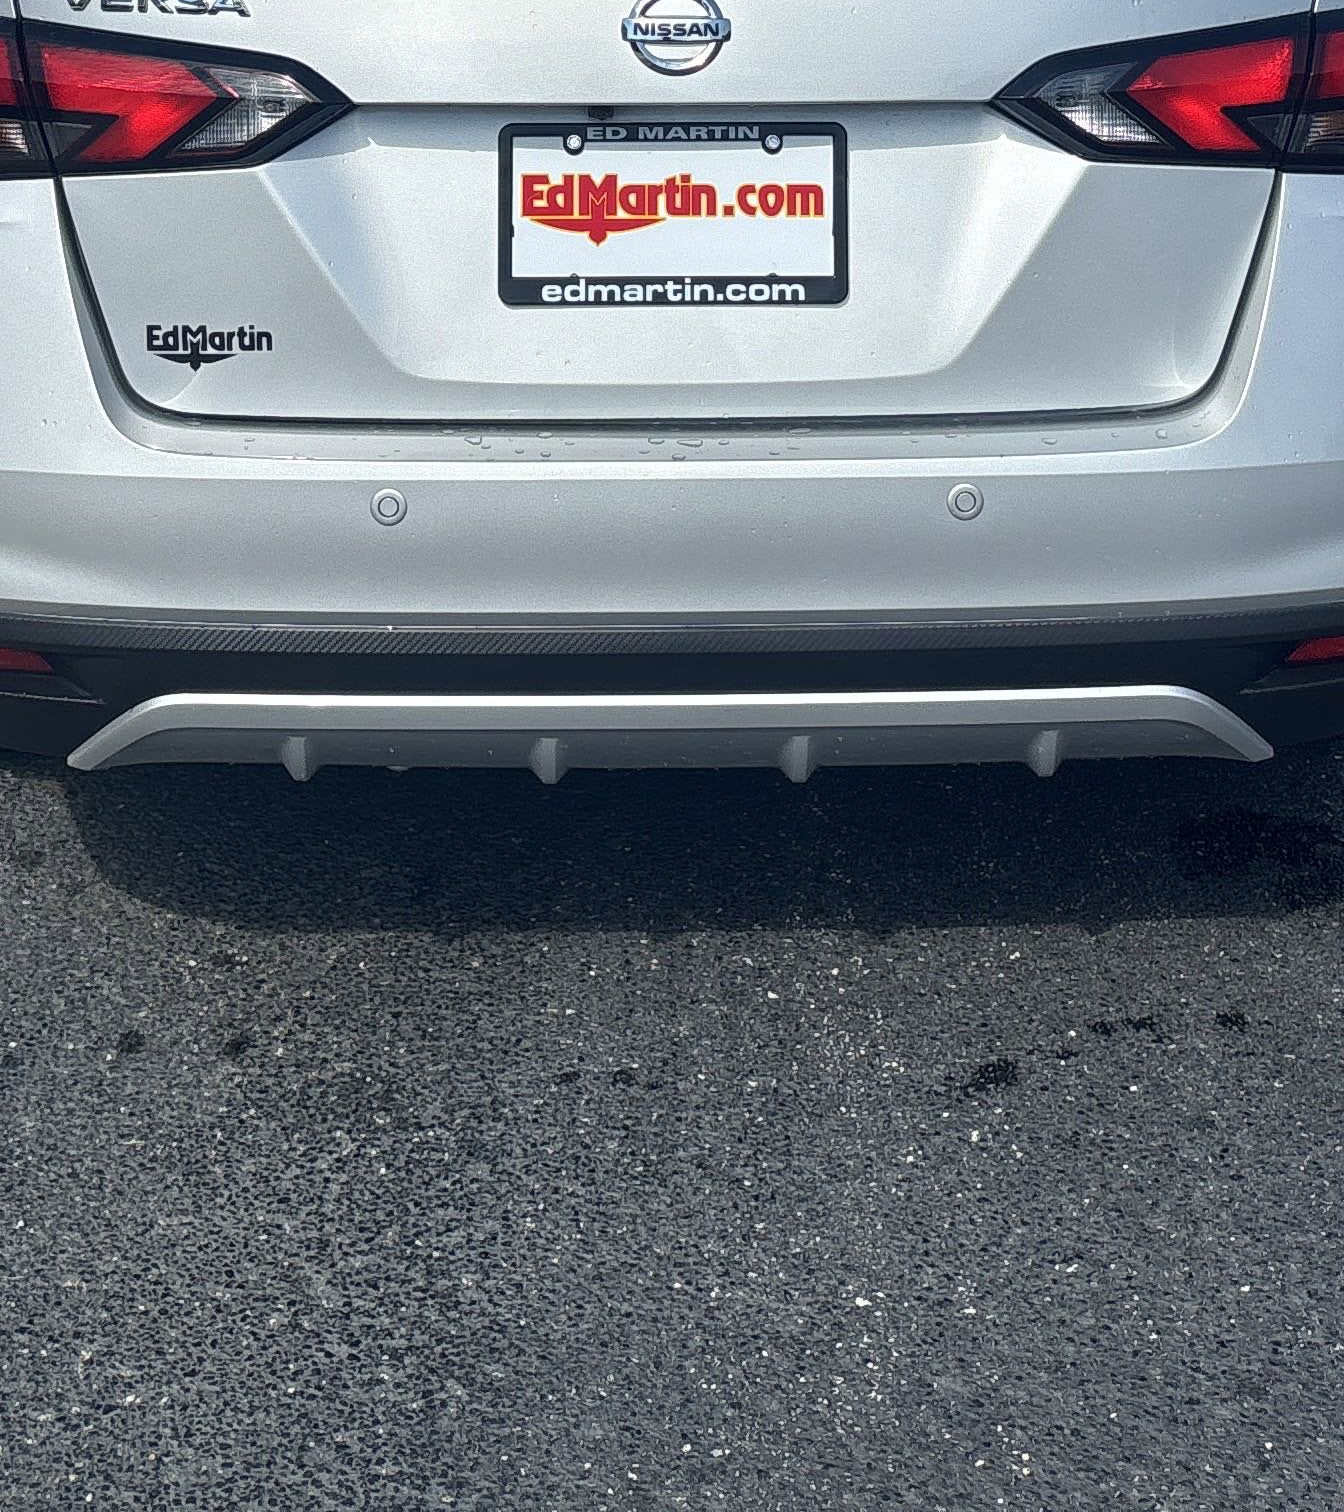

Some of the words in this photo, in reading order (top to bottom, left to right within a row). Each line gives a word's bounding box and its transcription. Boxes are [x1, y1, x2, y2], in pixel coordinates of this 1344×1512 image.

[632, 22, 720, 38] NISSAN
[586, 126, 627, 140] ED
[637, 126, 760, 140] MARTIN
[541, 277, 807, 303] edmartin.com
